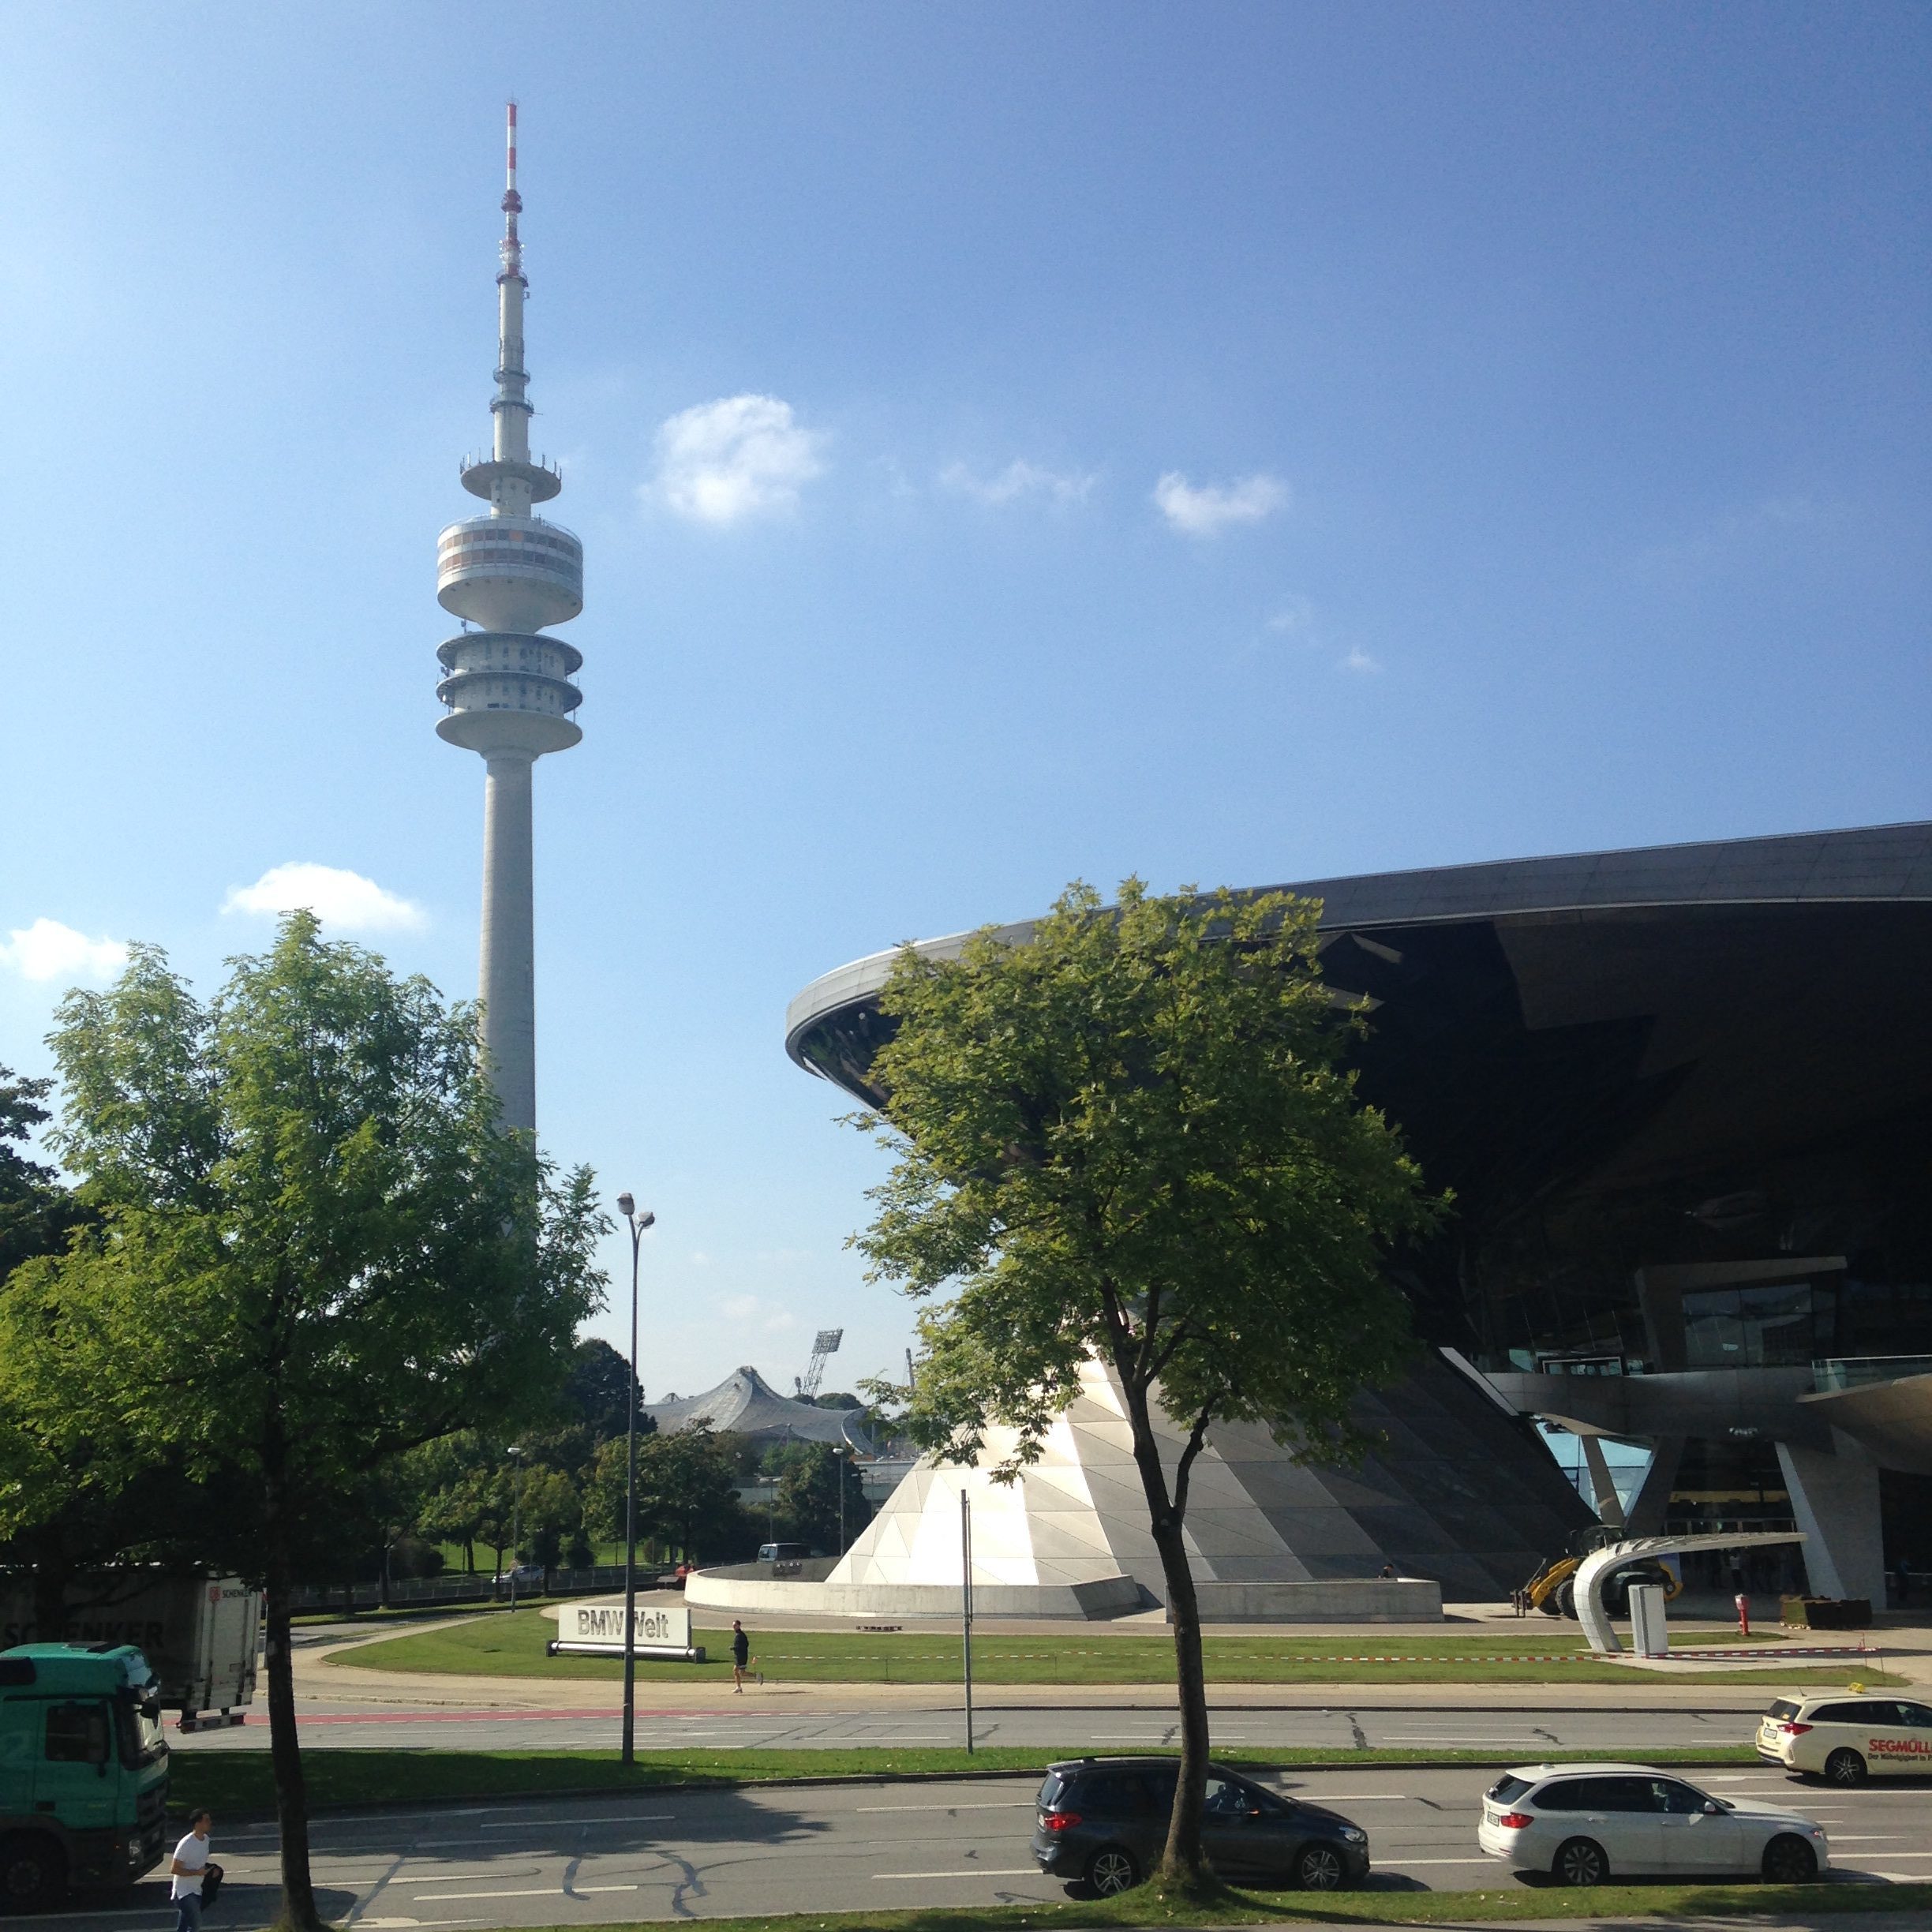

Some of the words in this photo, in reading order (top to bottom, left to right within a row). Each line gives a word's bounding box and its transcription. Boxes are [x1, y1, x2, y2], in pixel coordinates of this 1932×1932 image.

[5, 1622, 164, 1648] SCENKER
[578, 1609, 623, 1635] BMW
[634, 1611, 668, 1638] Welt
[1869, 1738, 1932, 1754] SEGMÜLL
